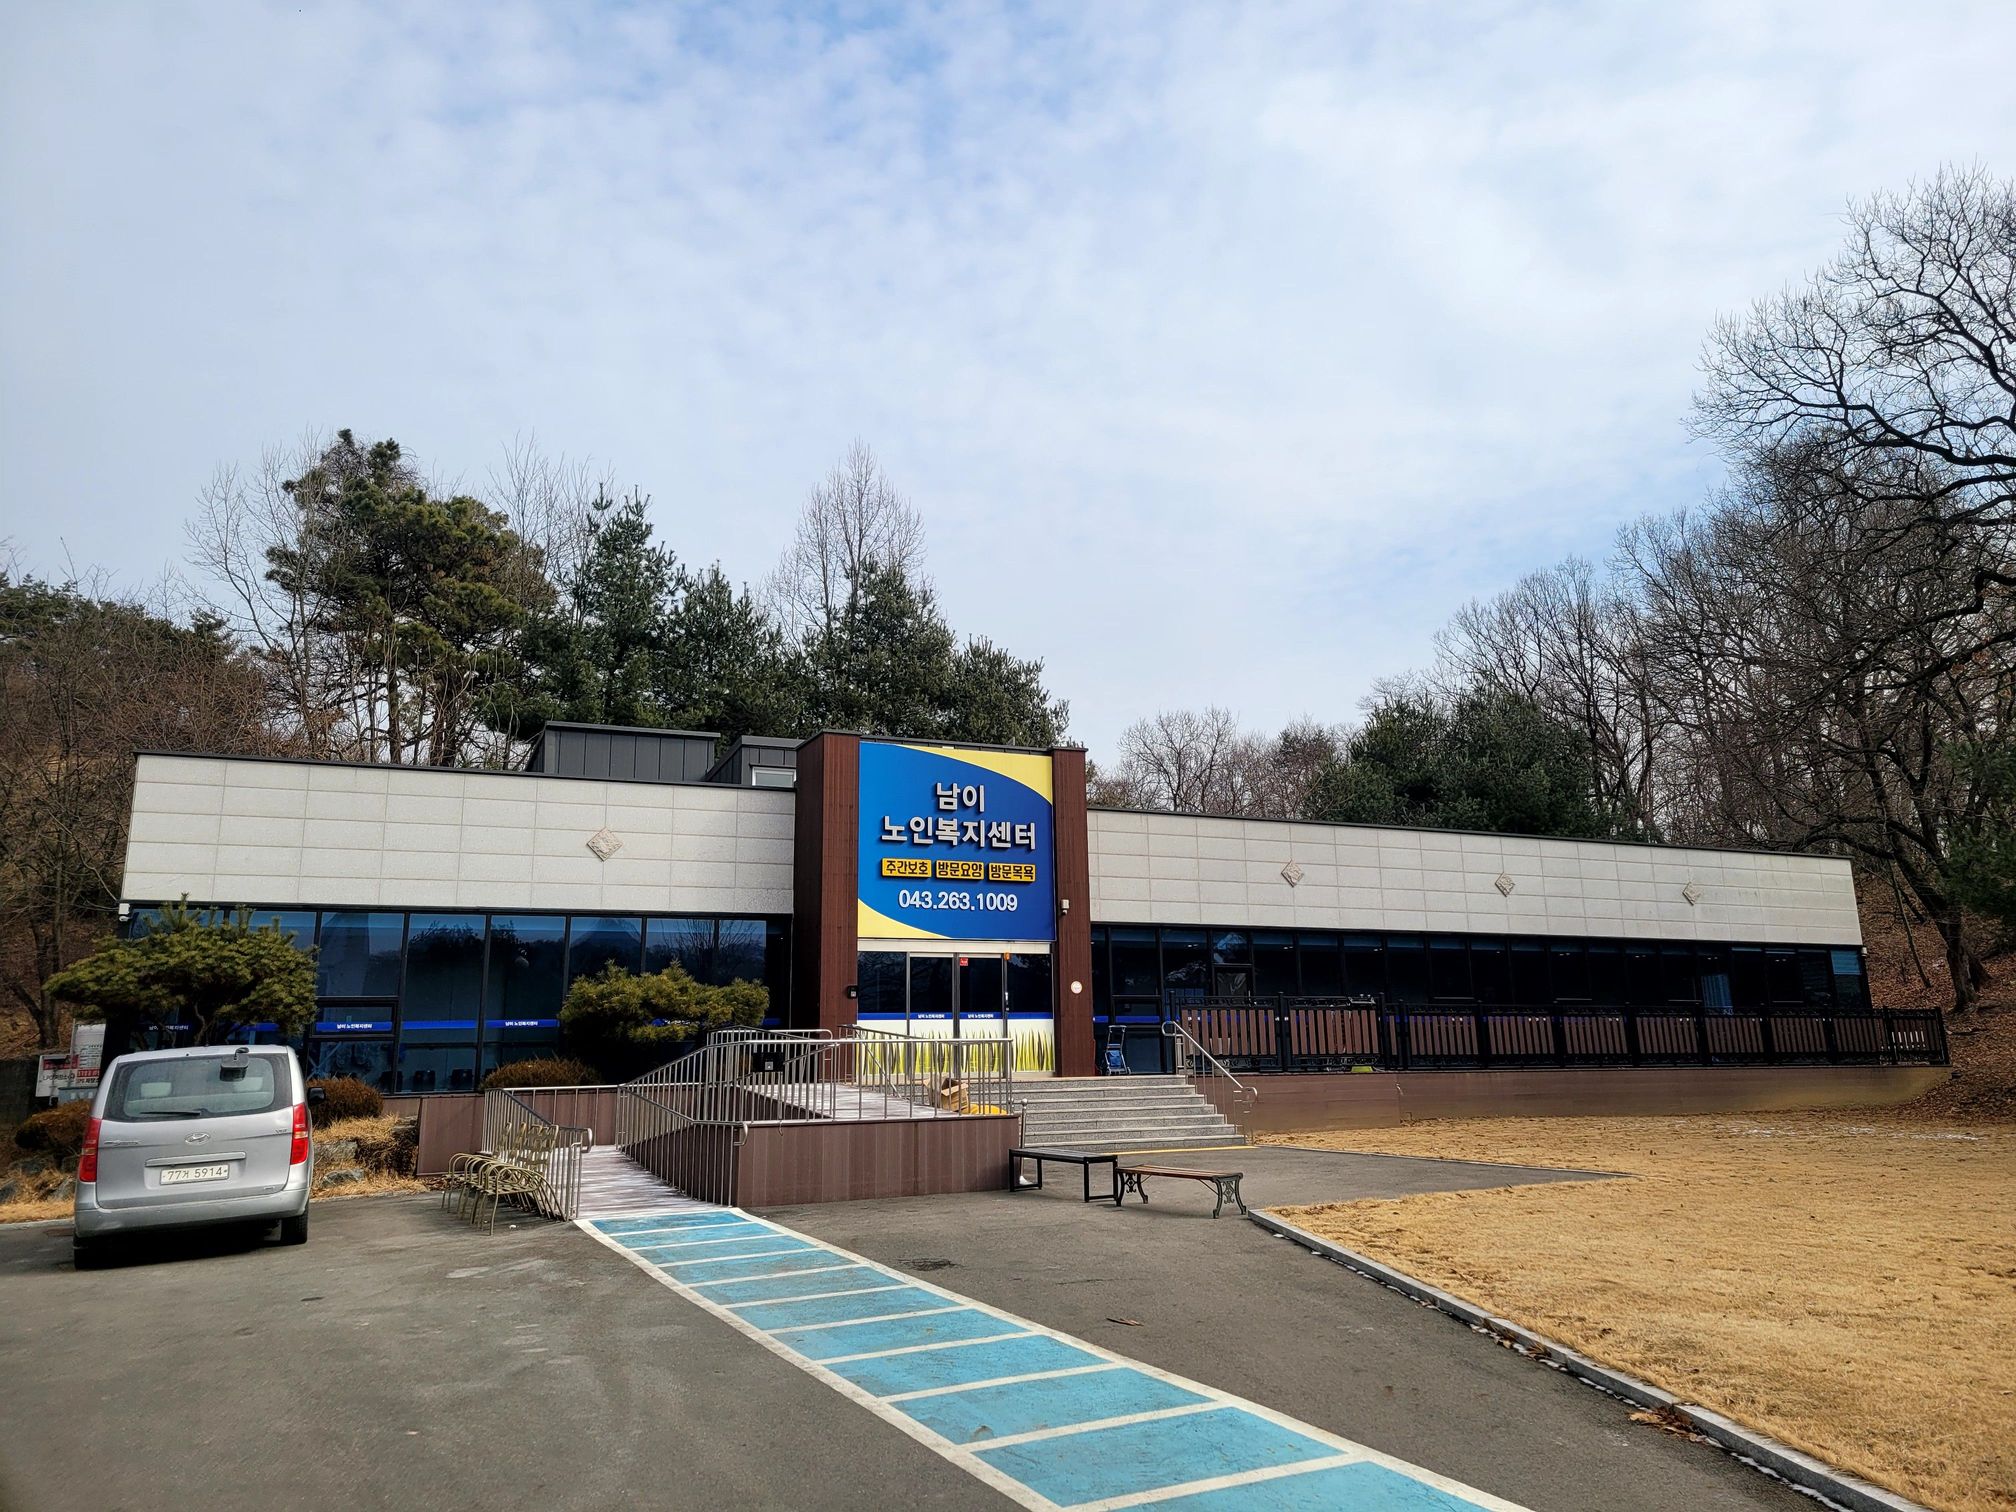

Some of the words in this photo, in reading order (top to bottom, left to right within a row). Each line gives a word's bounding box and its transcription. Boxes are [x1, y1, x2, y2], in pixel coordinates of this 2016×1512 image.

[936, 782, 985, 813] 남이
[881, 815, 1036, 850] 노인복지센터
[886, 860, 929, 875] 주간보호
[938, 861, 982, 878] 방문요양
[991, 864, 1034, 880] 방문목욕
[898, 889, 1018, 912] 043.263.1009
[194, 1166, 223, 1179] 5914
